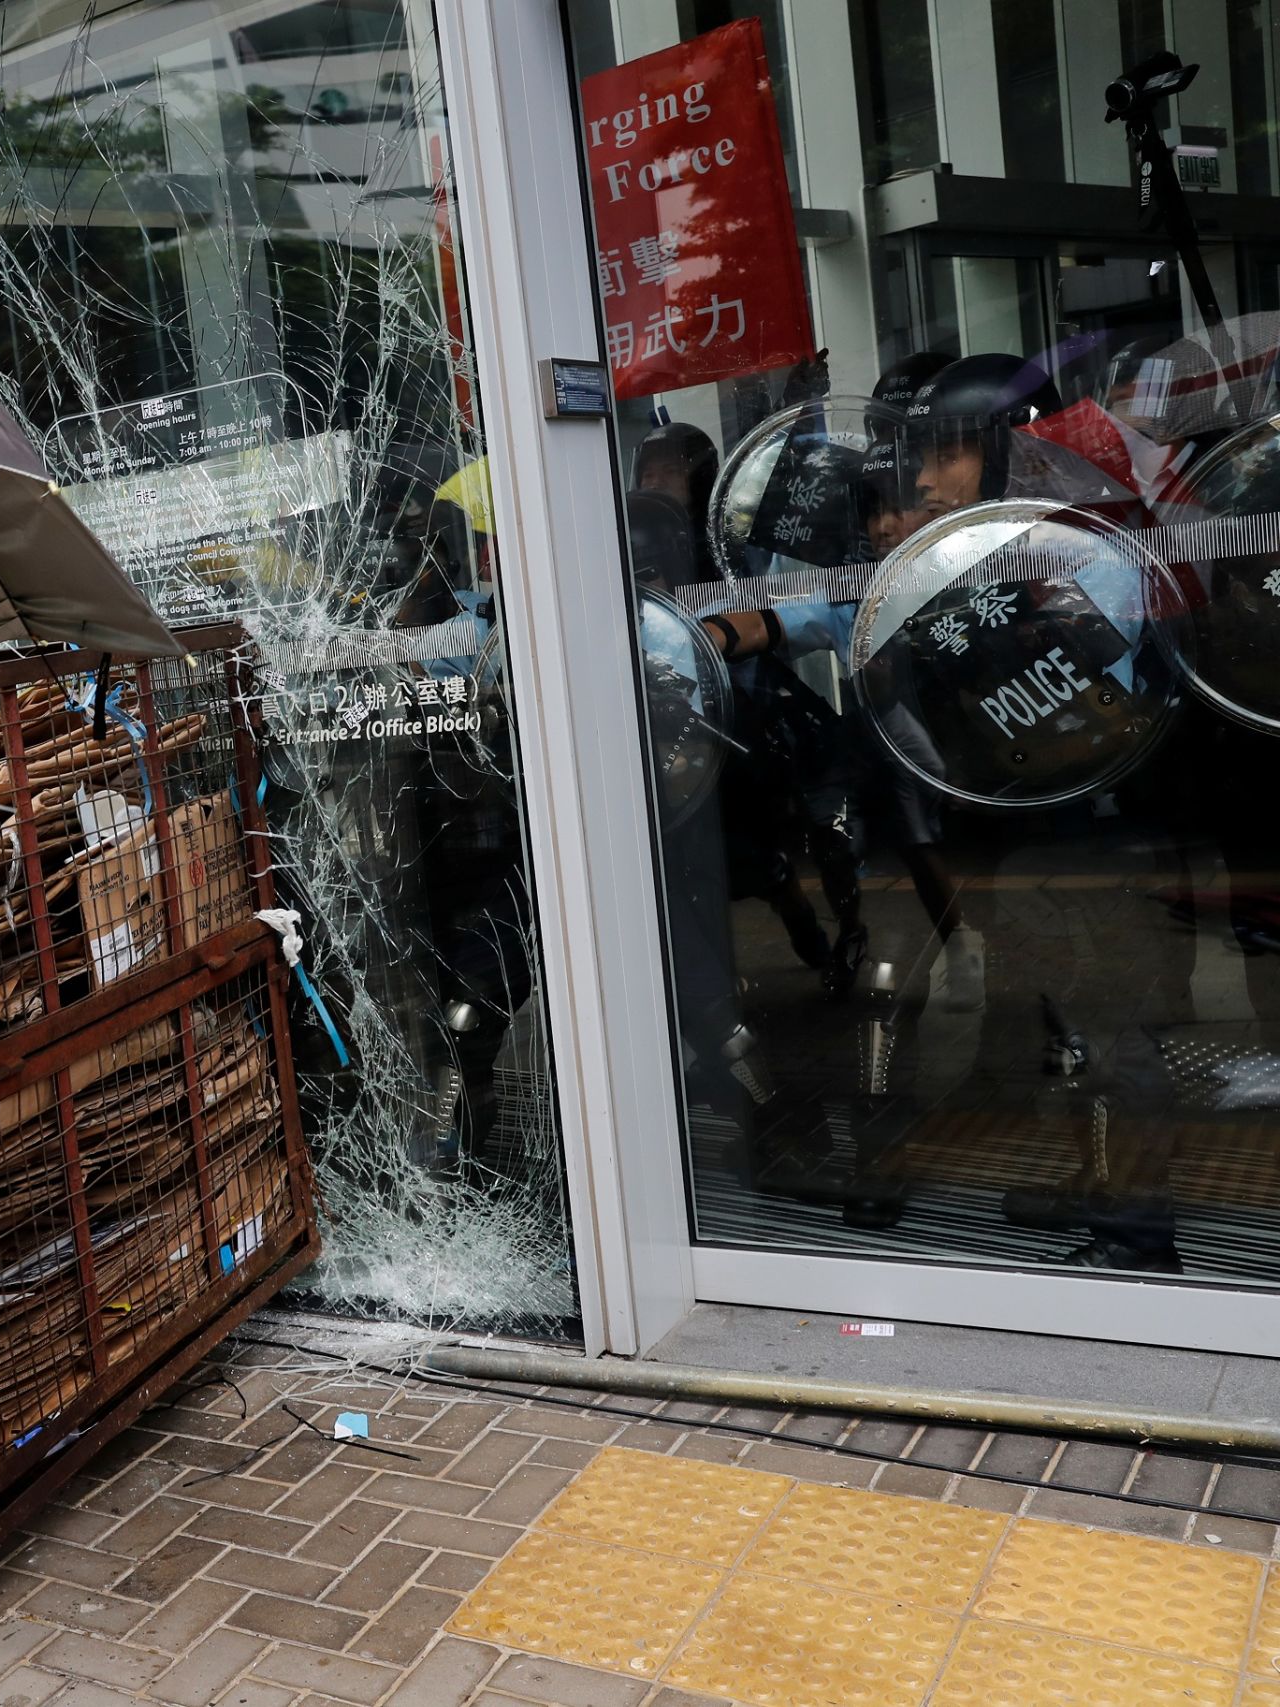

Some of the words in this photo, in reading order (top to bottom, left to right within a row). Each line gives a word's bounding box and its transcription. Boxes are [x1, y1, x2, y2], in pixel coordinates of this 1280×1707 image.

[589, 82, 711, 148] rging
[602, 138, 736, 203] Force
[1141, 177, 1150, 206] SIRUI
[883, 391, 912, 401] Police
[137, 418, 171, 432] Opening
[172, 413, 197, 424] hours
[179, 446, 197, 458] 7:00
[199, 445, 212, 454] am
[219, 437, 241, 449] 10:00
[243, 436, 257, 447] pm
[84, 461, 114, 476] Monday
[116, 462, 125, 470] to
[127, 456, 156, 470] Sunday
[862, 460, 893, 473] Police
[160, 546, 185, 556] please
[203, 539, 215, 547] the
[218, 535, 243, 545] Public
[187, 551, 217, 561] Council
[219, 544, 255, 557] Complex
[929, 579, 1018, 656] 警察
[979, 646, 1092, 739] POLICE
[277, 726, 348, 746] Entrance
[352, 723, 361, 739] 2
[366, 717, 422, 740] (Office
[426, 711, 481, 737] Block)
